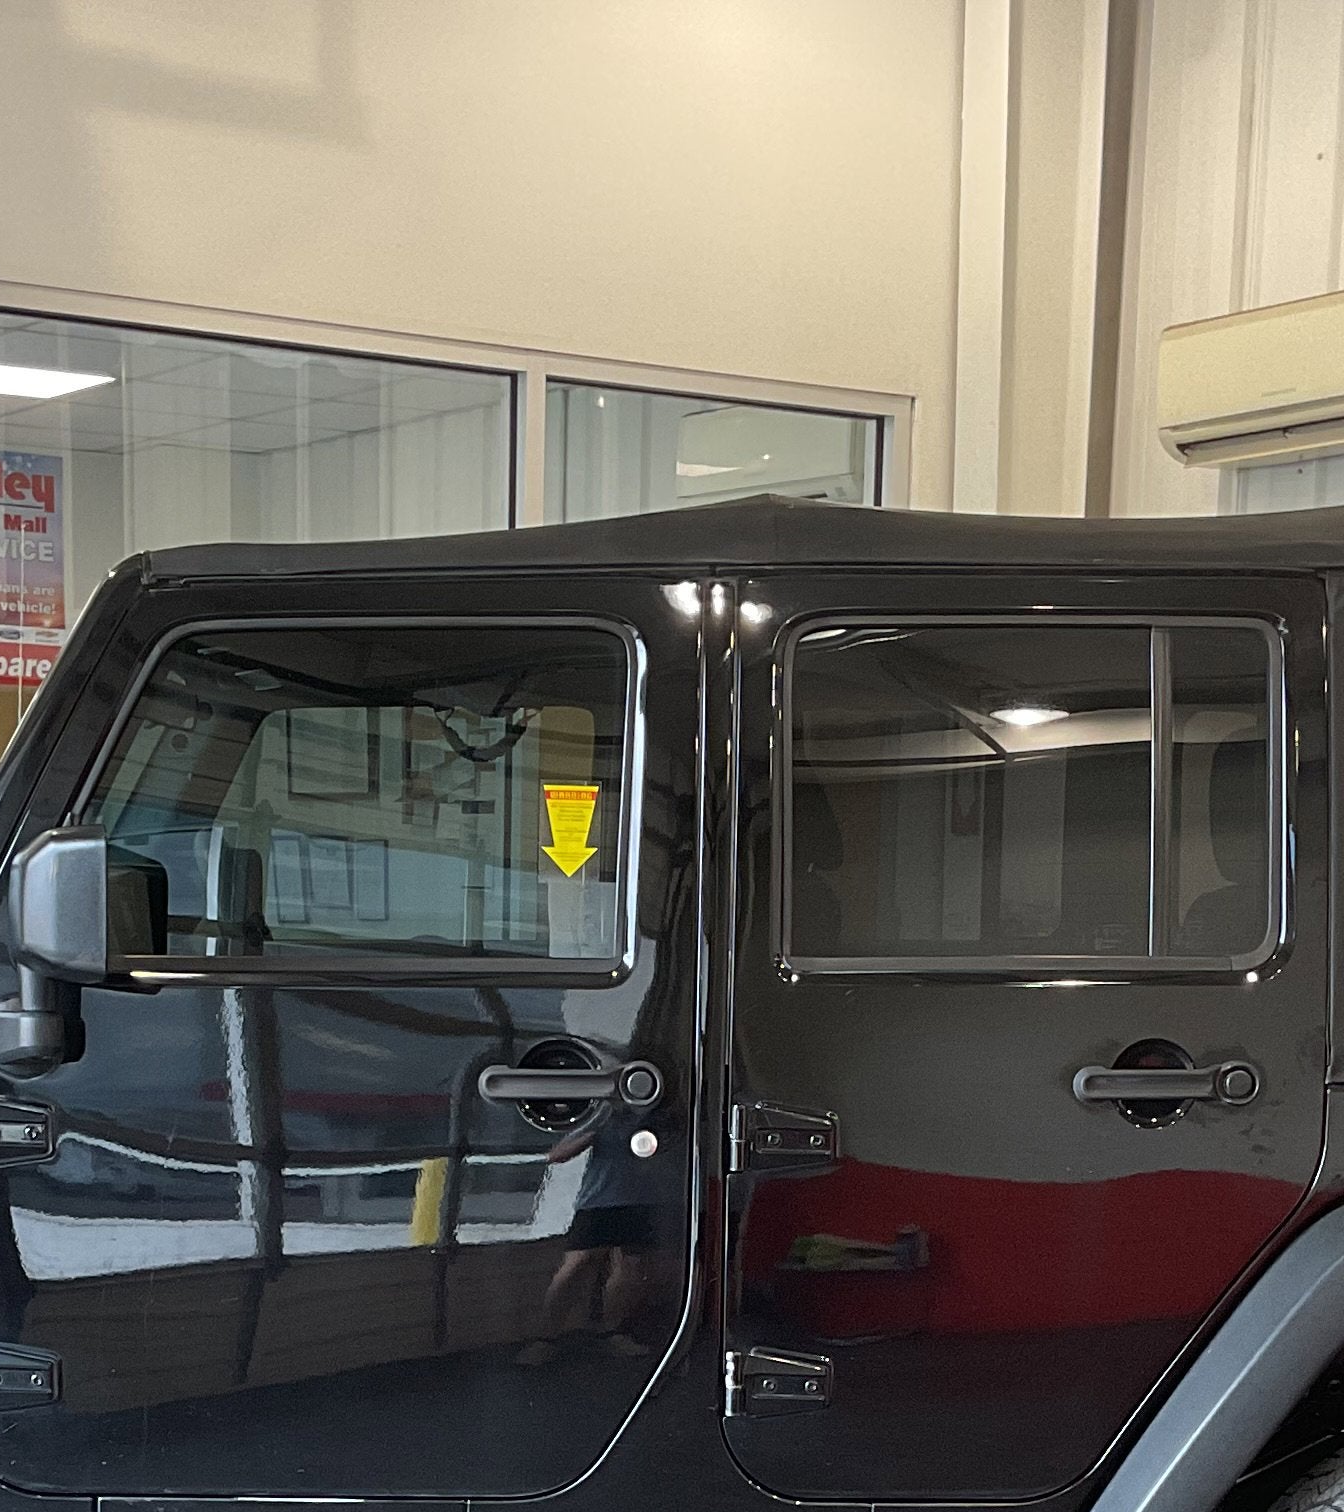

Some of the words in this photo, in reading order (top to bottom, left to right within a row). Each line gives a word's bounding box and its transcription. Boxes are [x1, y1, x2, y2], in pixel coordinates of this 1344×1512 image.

[4, 514, 47, 534] Mall
[33, 586, 55, 596] are
[0, 600, 56, 615] vehicle!
